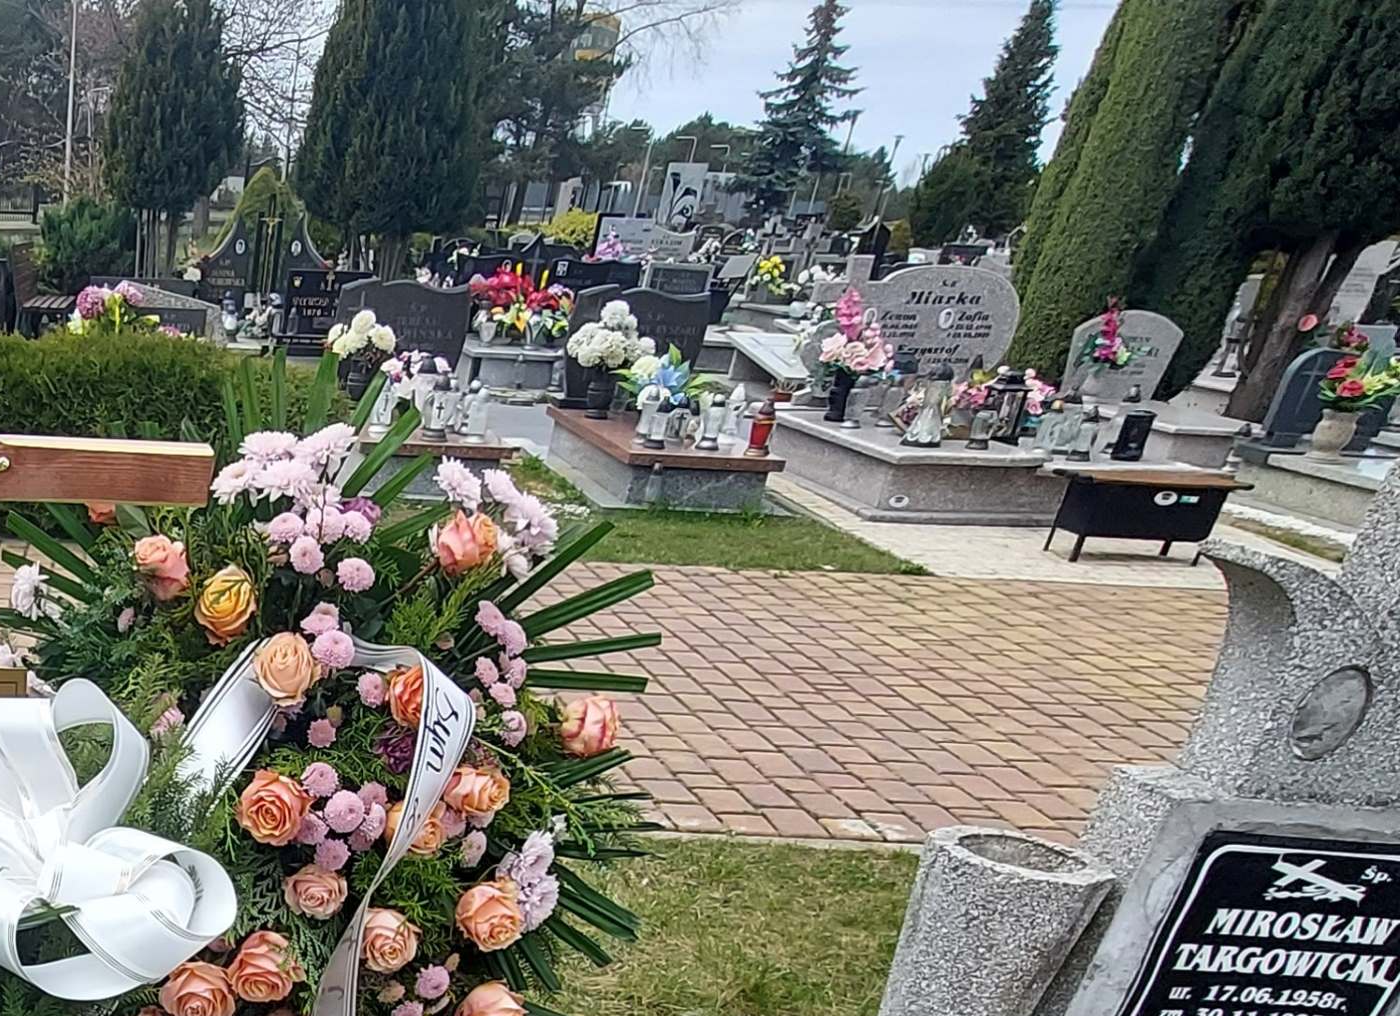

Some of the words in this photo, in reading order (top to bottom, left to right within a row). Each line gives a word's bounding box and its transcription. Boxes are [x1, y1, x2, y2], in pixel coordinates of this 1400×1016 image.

[424, 686, 459, 774] Syn
[1204, 907, 1399, 946] MIROSŁAW
[1172, 943, 1398, 987] TARGOWICKI
[1168, 986, 1192, 1001] ur.
